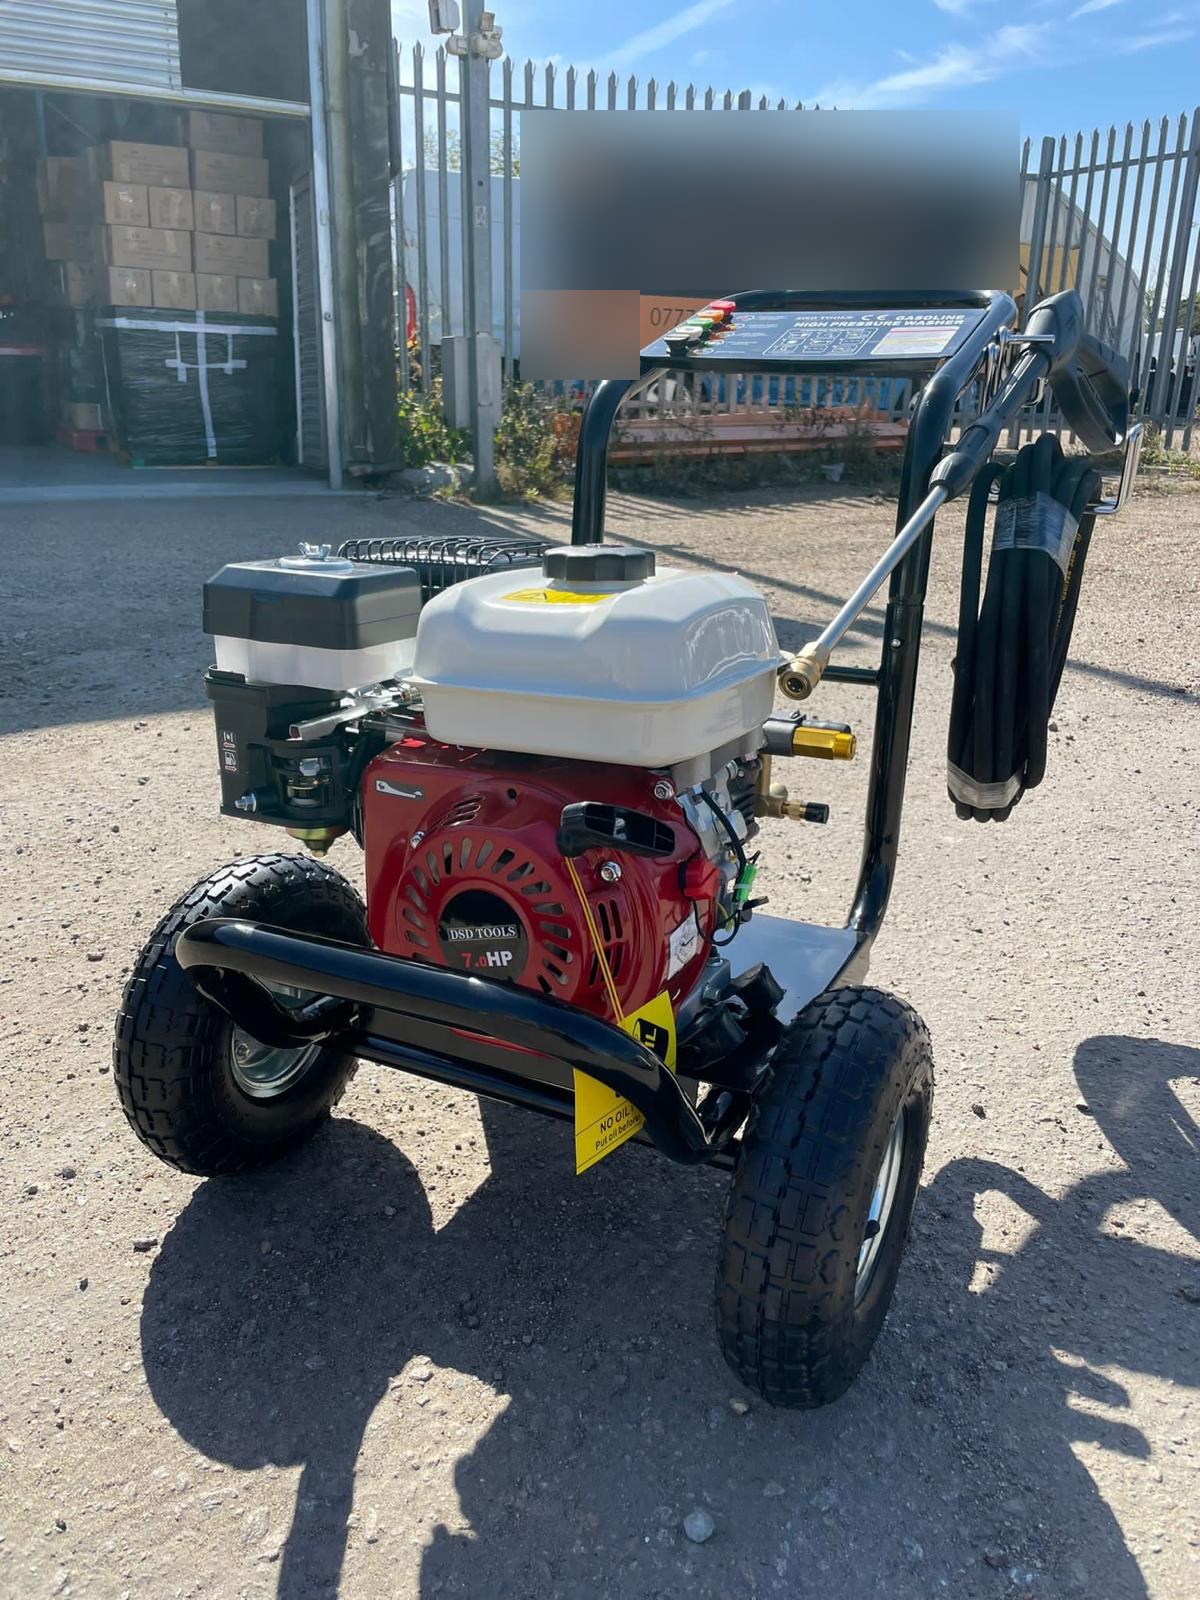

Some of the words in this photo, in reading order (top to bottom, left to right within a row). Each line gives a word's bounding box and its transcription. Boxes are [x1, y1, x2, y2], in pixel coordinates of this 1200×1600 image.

[903, 319, 965, 327] WASHER
[450, 928, 474, 940] DSD
[475, 926, 516, 939] TOOLS
[600, 1117, 614, 1134] NO
[615, 1105, 631, 1123] OIL
[595, 1136, 608, 1151] Put
[608, 1128, 618, 1141] oil
